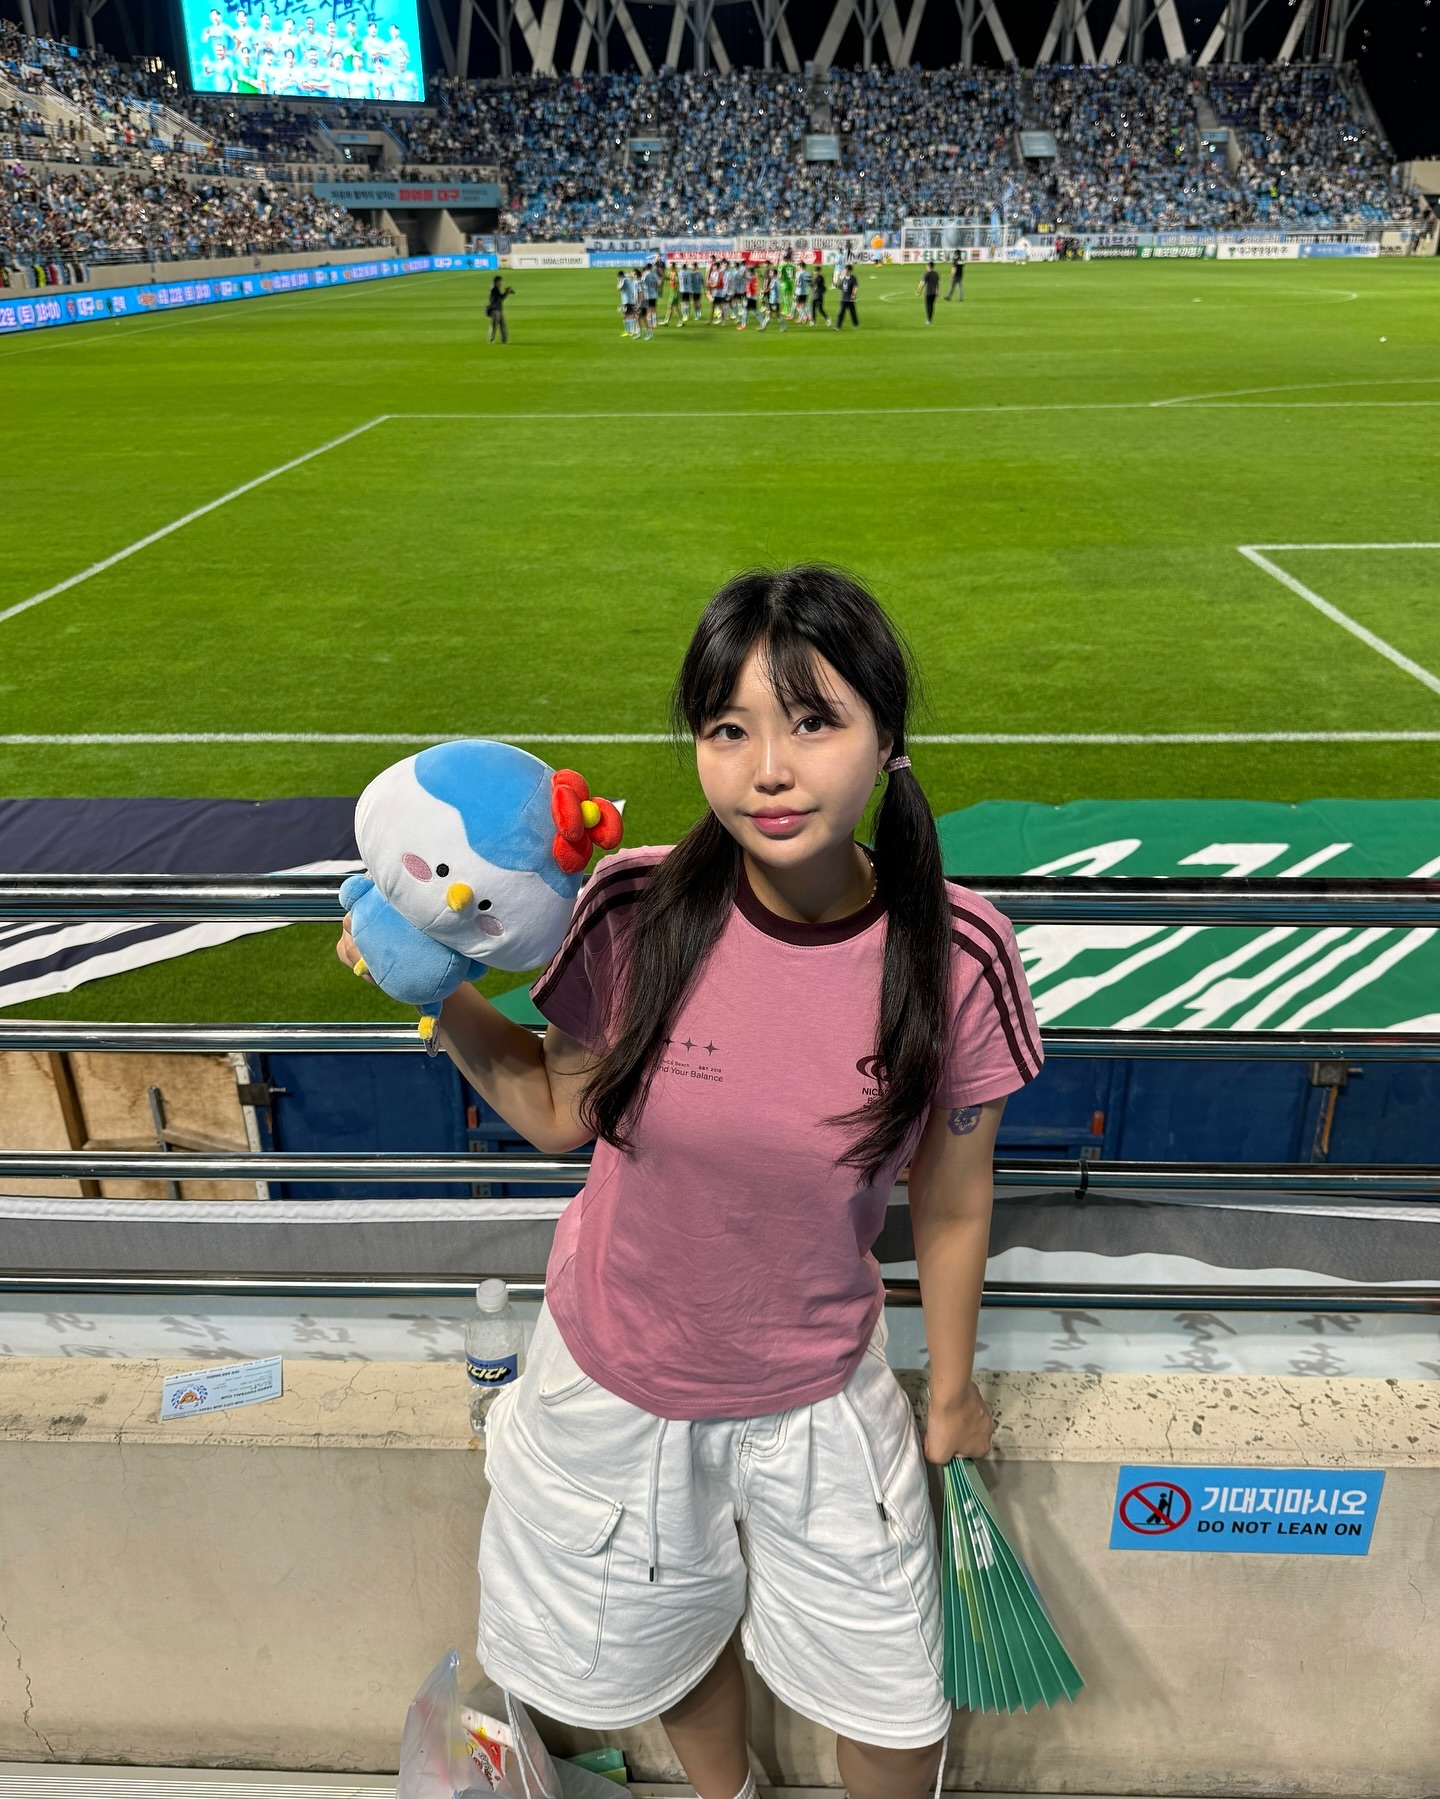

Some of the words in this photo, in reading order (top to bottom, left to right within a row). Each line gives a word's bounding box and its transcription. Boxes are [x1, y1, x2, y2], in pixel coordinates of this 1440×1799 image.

[76, 297, 94, 316] 대구
[671, 1067, 688, 1076] Your
[690, 1070, 724, 1083] Balance
[1200, 1487, 1367, 1516] 기대지마시오
[1197, 1520, 1225, 1533] DO
[1231, 1521, 1271, 1534] NOT
[1277, 1522, 1327, 1535] LEAN
[1334, 1523, 1362, 1536] ON
